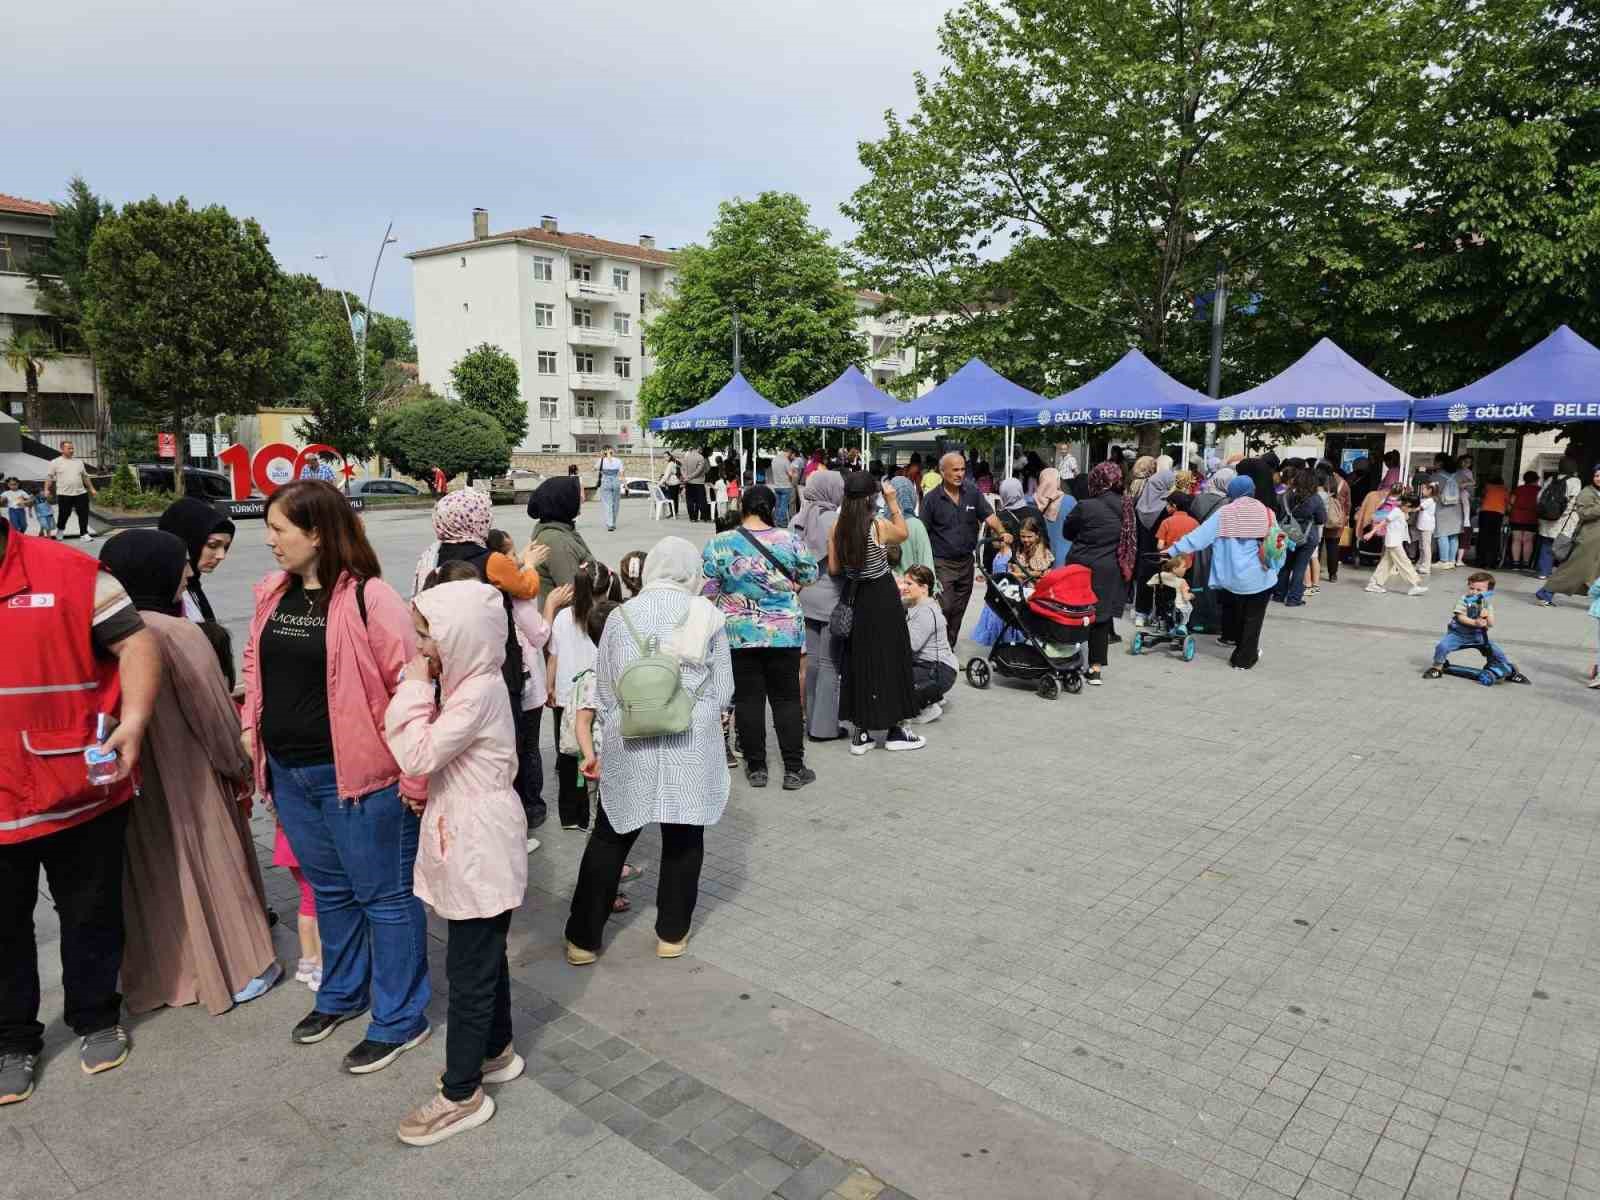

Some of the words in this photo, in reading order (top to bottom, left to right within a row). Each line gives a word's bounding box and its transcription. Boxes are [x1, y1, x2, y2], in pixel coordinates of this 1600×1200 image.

[1054, 407, 1093, 423] GÖLCÜK
[1239, 403, 1287, 419] GÖLCÜK
[1296, 403, 1376, 419] BELEDİYESİ
[1475, 401, 1536, 418] GÖLCÜK
[1553, 402, 1600, 417] BELE
